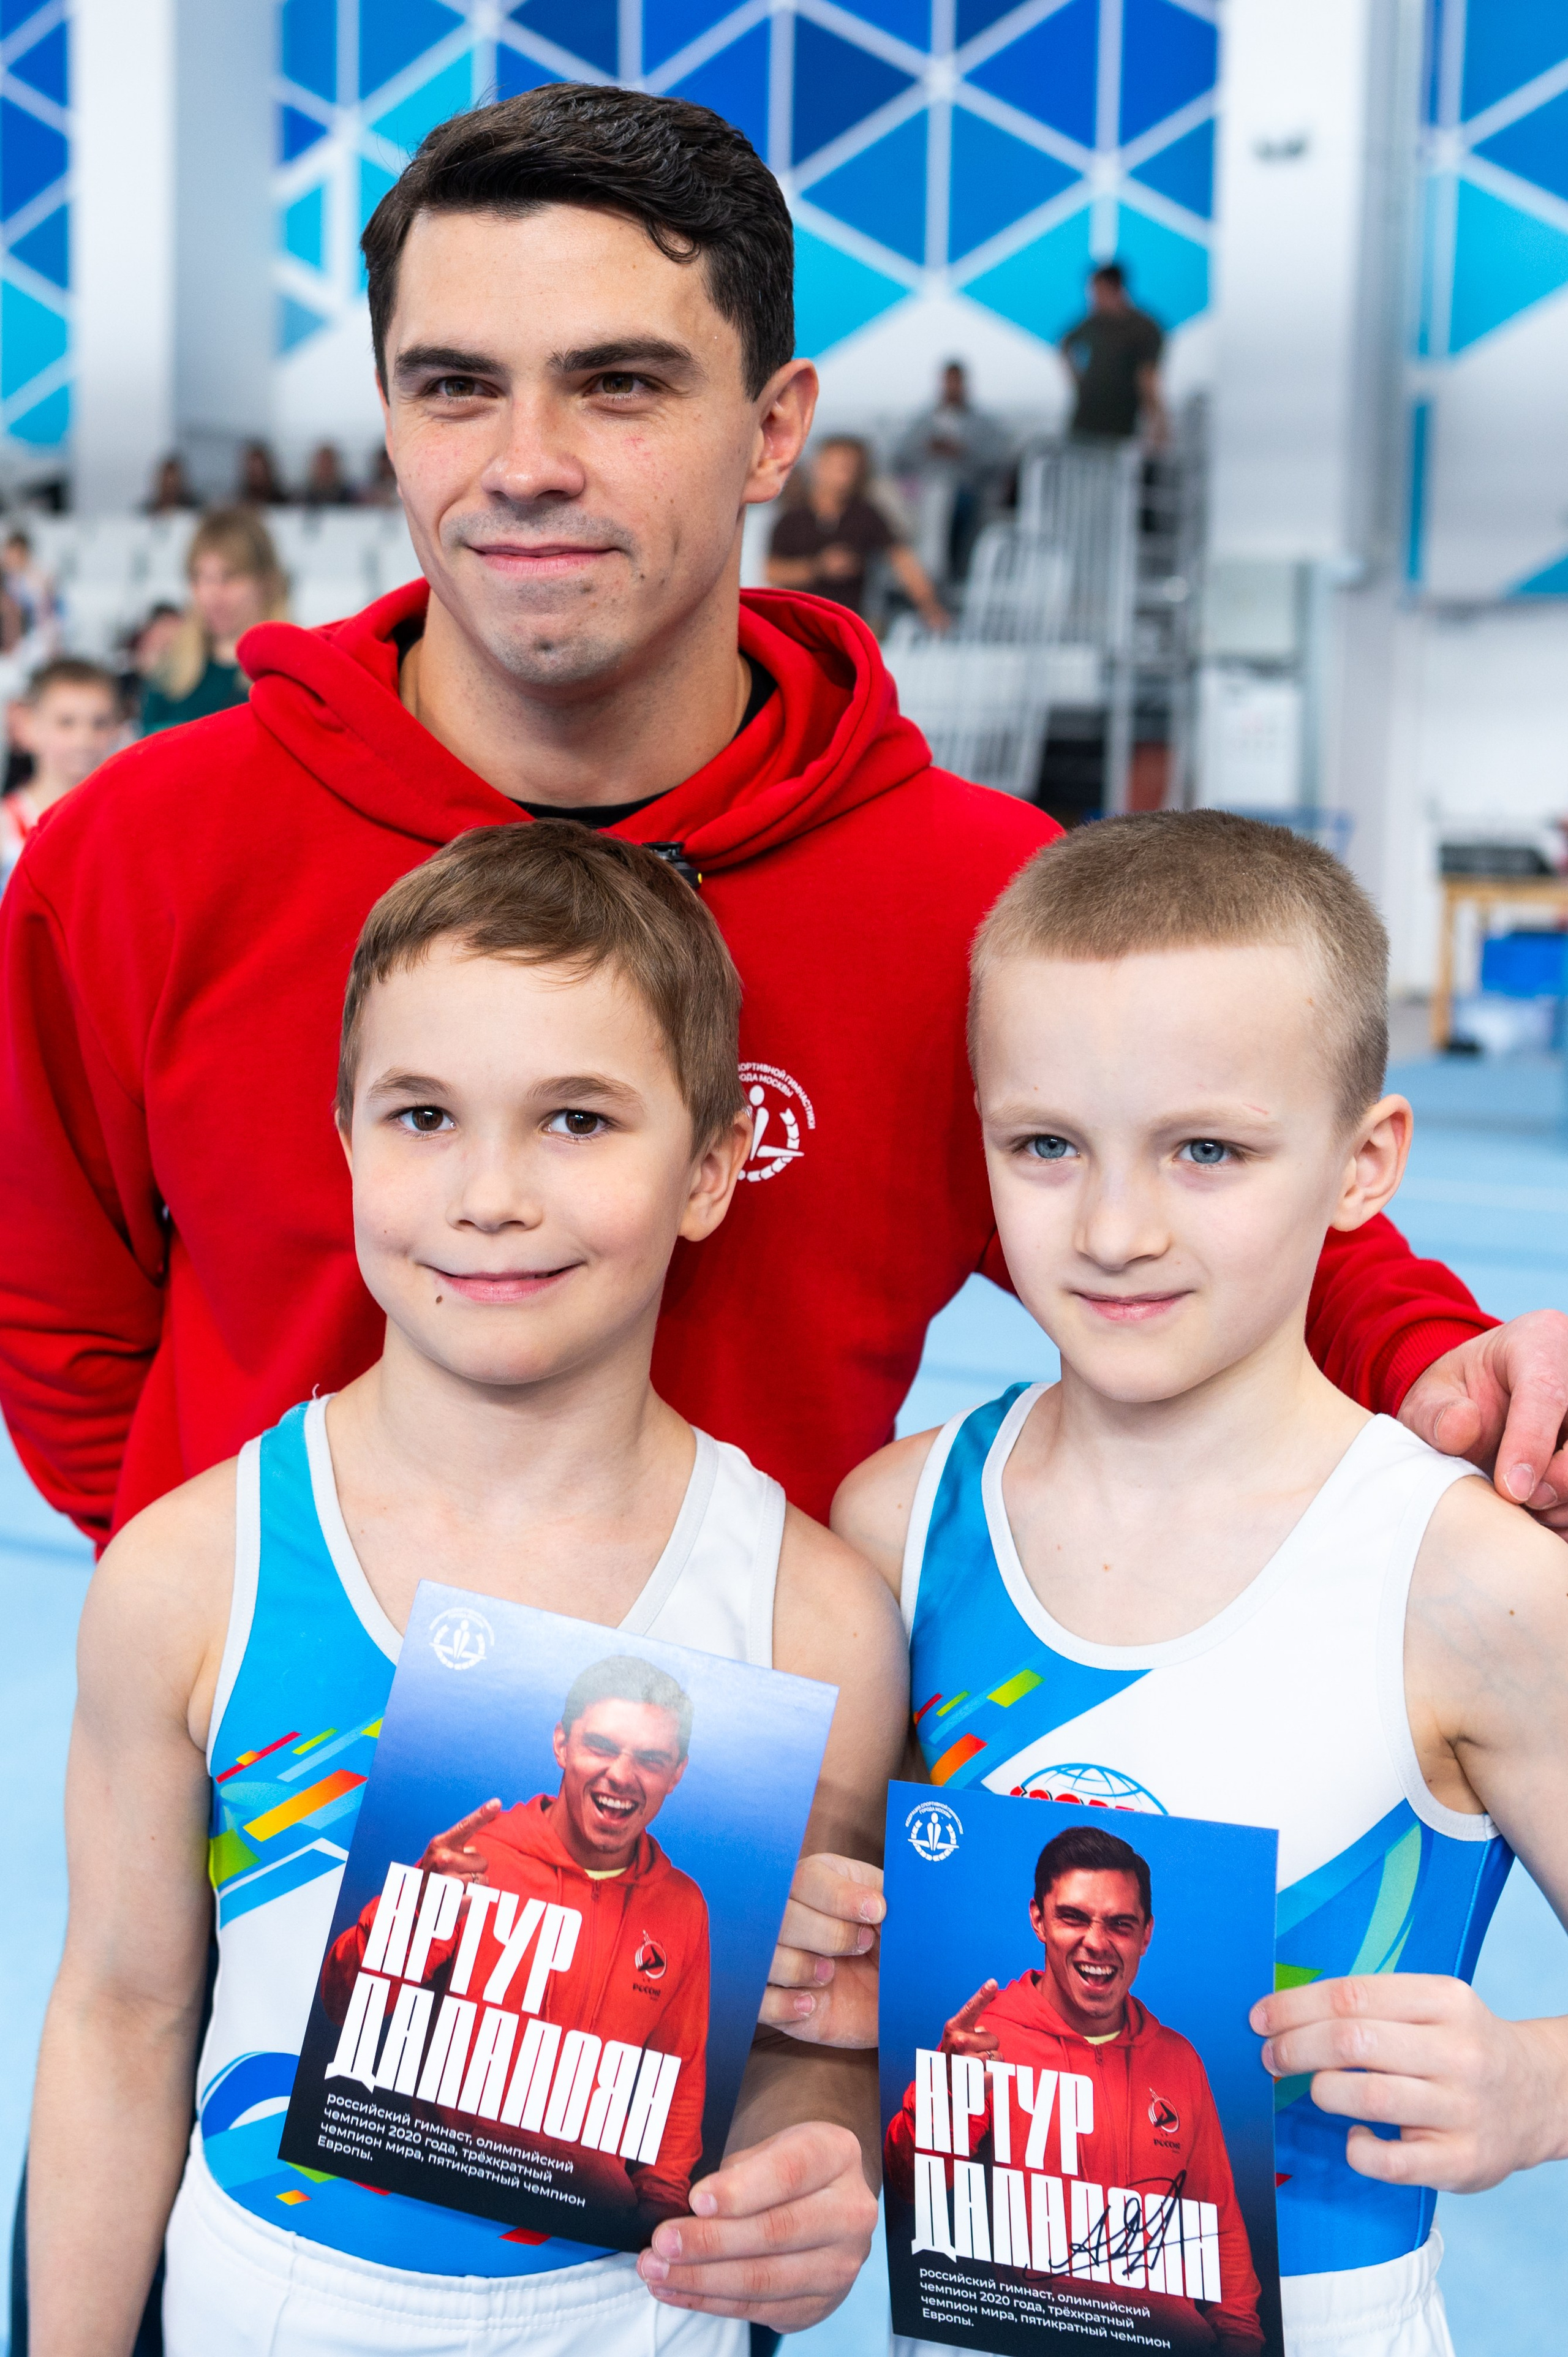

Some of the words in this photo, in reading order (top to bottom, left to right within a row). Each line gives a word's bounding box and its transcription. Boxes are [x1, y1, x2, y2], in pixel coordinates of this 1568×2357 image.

[737, 1062, 786, 1080] ОРТИВНОЙ
[758, 1074, 794, 1098] МОСКВЫ
[361, 1861, 582, 2015] АРТУР
[324, 1970, 682, 2166] ДАЛАЛОЯН
[326, 2093, 411, 2126] российский
[414, 2118, 472, 2146] гимнаст,
[476, 2137, 574, 2174] олимпийский
[915, 2048, 1094, 2176] АРТУР
[317, 2134, 373, 2161] Европы.
[320, 2121, 382, 2148] чемпион
[385, 2141, 424, 2162] мира,
[428, 2153, 520, 2189] пятикратный
[523, 2180, 586, 2208] чемпион
[323, 2107, 385, 2133] чемпион
[388, 2124, 422, 2144] 2020
[425, 2137, 458, 2157] года,
[462, 2147, 552, 2183] трёхкратный
[911, 2152, 1222, 2303] ДАЛАЛОЯН
[919, 2268, 996, 2290] российский
[1000, 2282, 1055, 2302] гимнаст,
[1057, 2293, 1151, 2318] олимпийский
[919, 2281, 977, 2300] чемпион
[979, 2291, 1010, 2306] 2020
[1013, 2299, 1046, 2315] года,
[1047, 2305, 1134, 2329] трёхкратный
[921, 2295, 978, 2314] чемпион
[981, 2306, 1017, 2323] мира,
[1020, 2314, 1107, 2338] пятикратный
[1110, 2329, 1171, 2350] чемпион
[922, 2307, 974, 2326] Европы.
